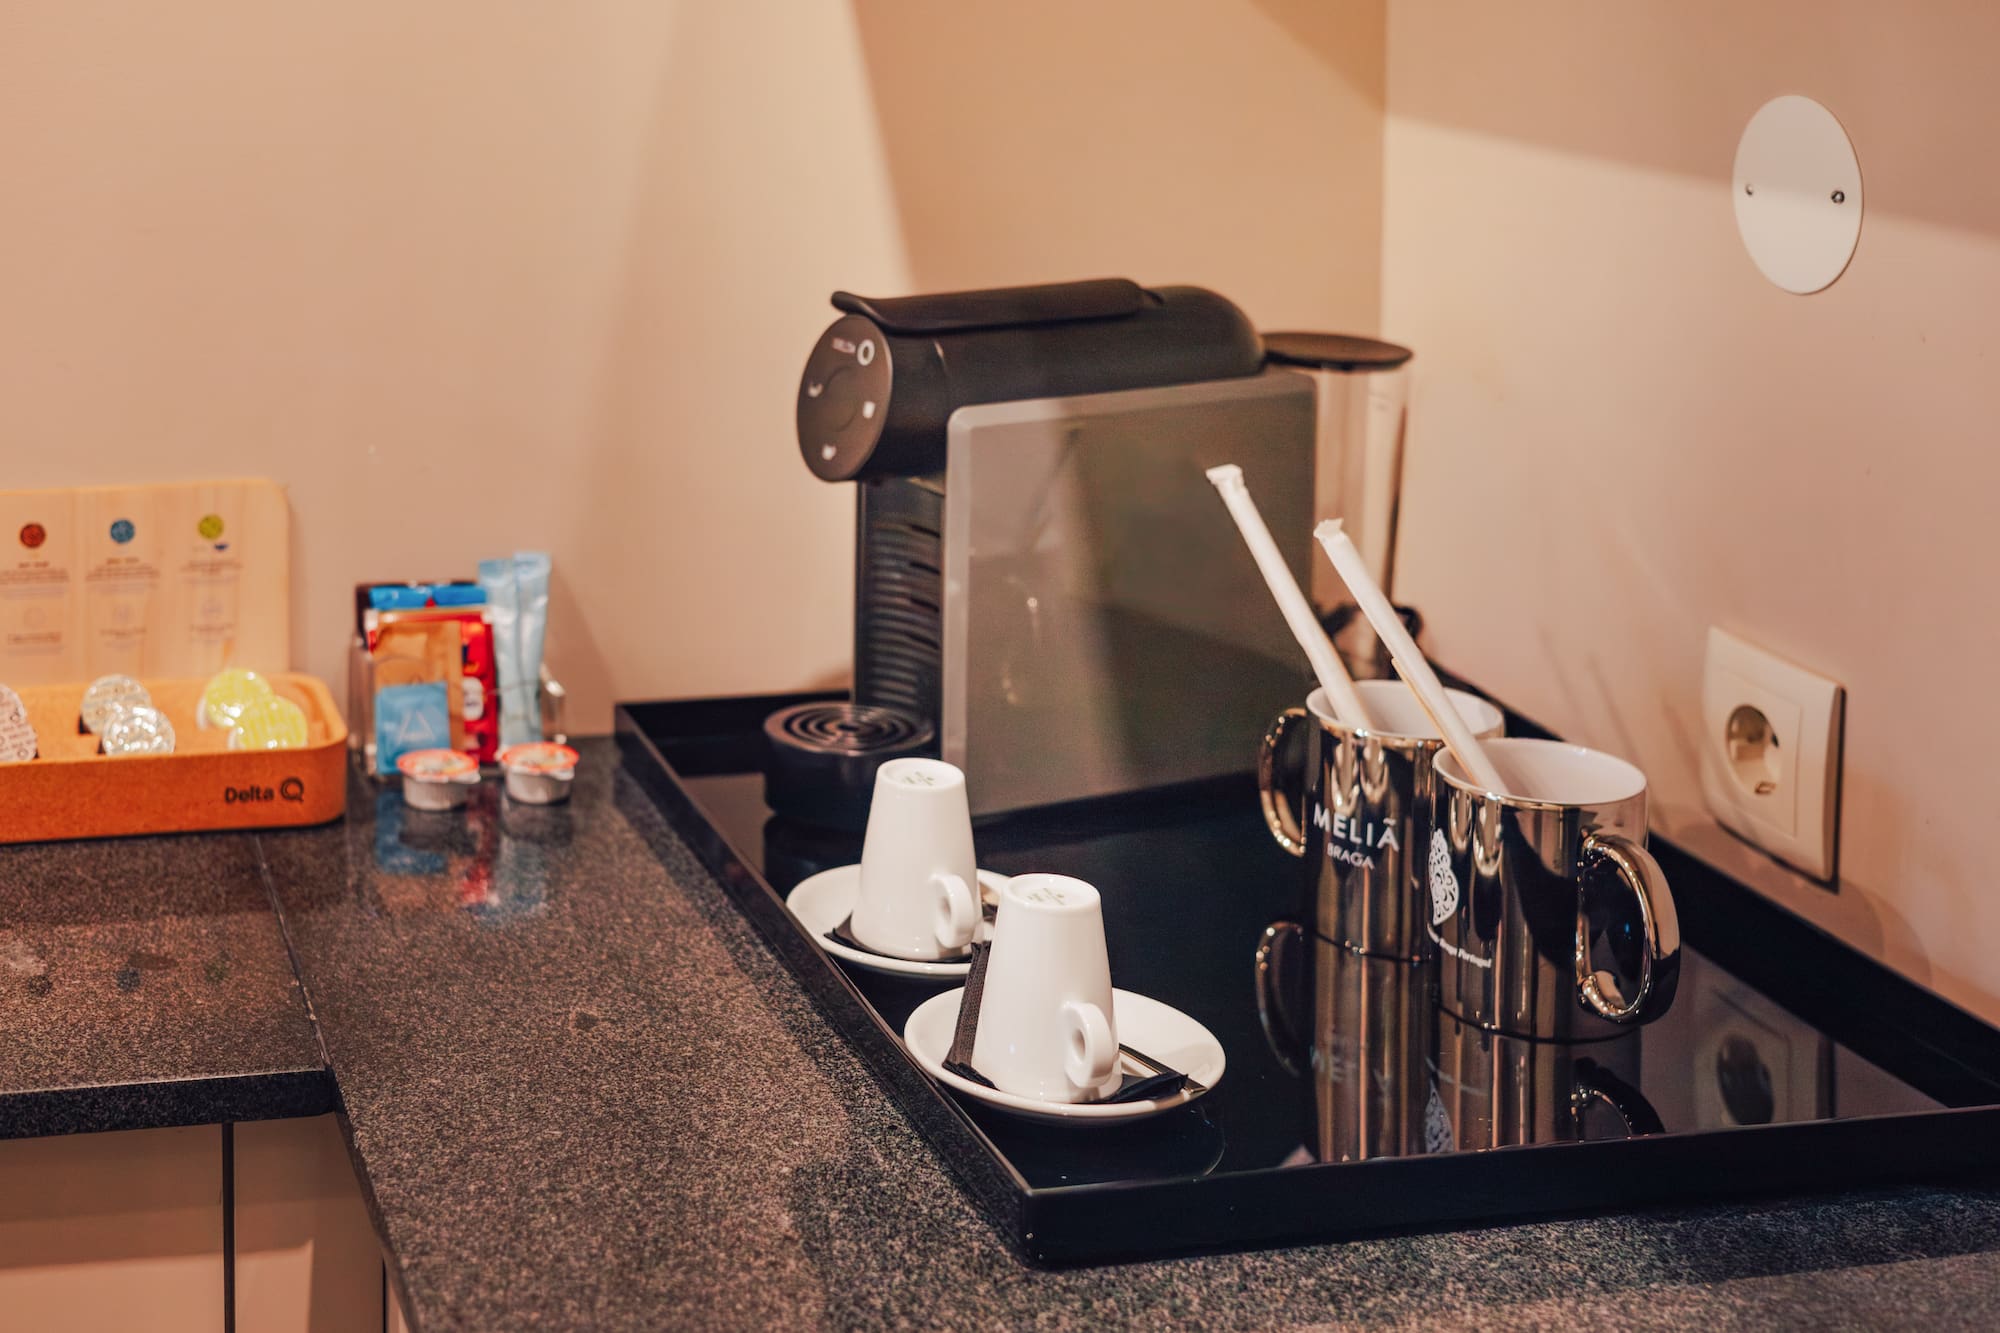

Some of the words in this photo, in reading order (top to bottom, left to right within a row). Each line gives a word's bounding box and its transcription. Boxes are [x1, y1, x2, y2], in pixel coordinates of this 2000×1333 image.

[224, 785, 275, 804] Delta
[280, 776, 305, 804] Q
[1327, 842, 1375, 870] BRAGA
